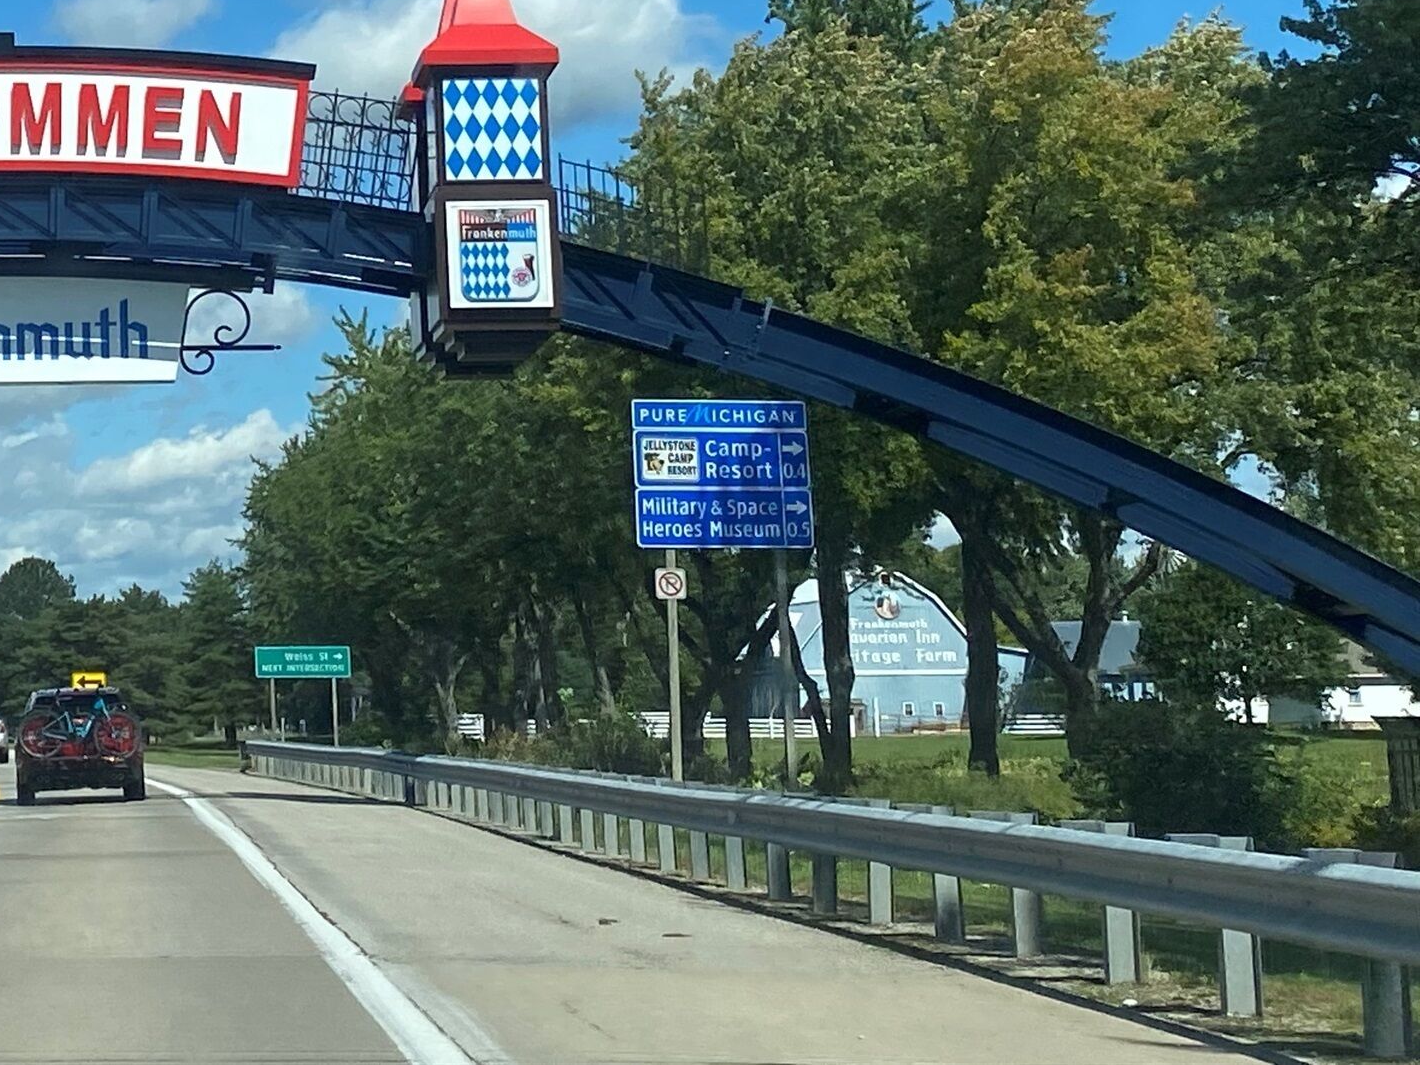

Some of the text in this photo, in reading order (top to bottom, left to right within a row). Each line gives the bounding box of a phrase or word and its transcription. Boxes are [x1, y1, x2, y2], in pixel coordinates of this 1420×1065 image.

[462, 225, 537, 240] Frankenmuth
[640, 403, 795, 425] PURE MICHIGAN
[643, 440, 696, 452] JELLYSTONE
[705, 439, 772, 460] Camp-
[667, 453, 694, 464] CAMP
[667, 465, 697, 476] RESORT
[705, 461, 773, 479] Resort
[783, 463, 806, 479] 0.4
[642, 497, 779, 520] Military & Space
[642, 520, 781, 538] Heroes Museum
[850, 629, 941, 644] avarian Inn
[915, 647, 958, 664] Farm
